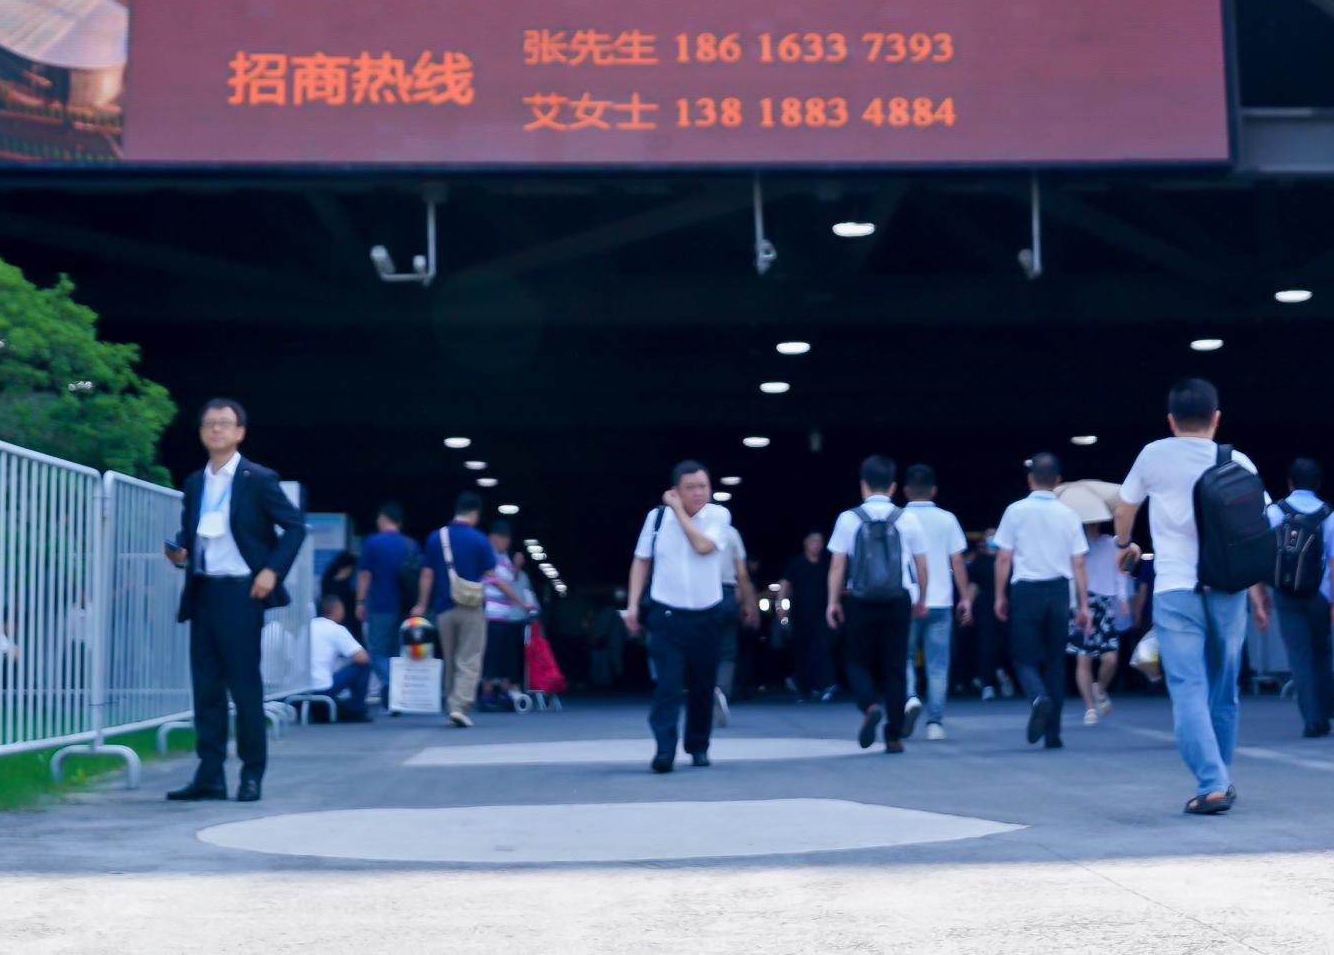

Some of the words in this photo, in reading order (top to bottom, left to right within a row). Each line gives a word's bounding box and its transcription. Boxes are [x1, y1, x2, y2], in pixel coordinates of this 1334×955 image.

[523, 29, 658, 65] 张先生
[675, 32, 741, 64] 186
[759, 32, 847, 63] 1633
[862, 32, 954, 63] 7393
[227, 51, 474, 106] 招商热线
[523, 92, 659, 131] 艾女士
[676, 97, 741, 128] 138
[759, 97, 848, 128] 1883
[862, 97, 956, 128] 4884
